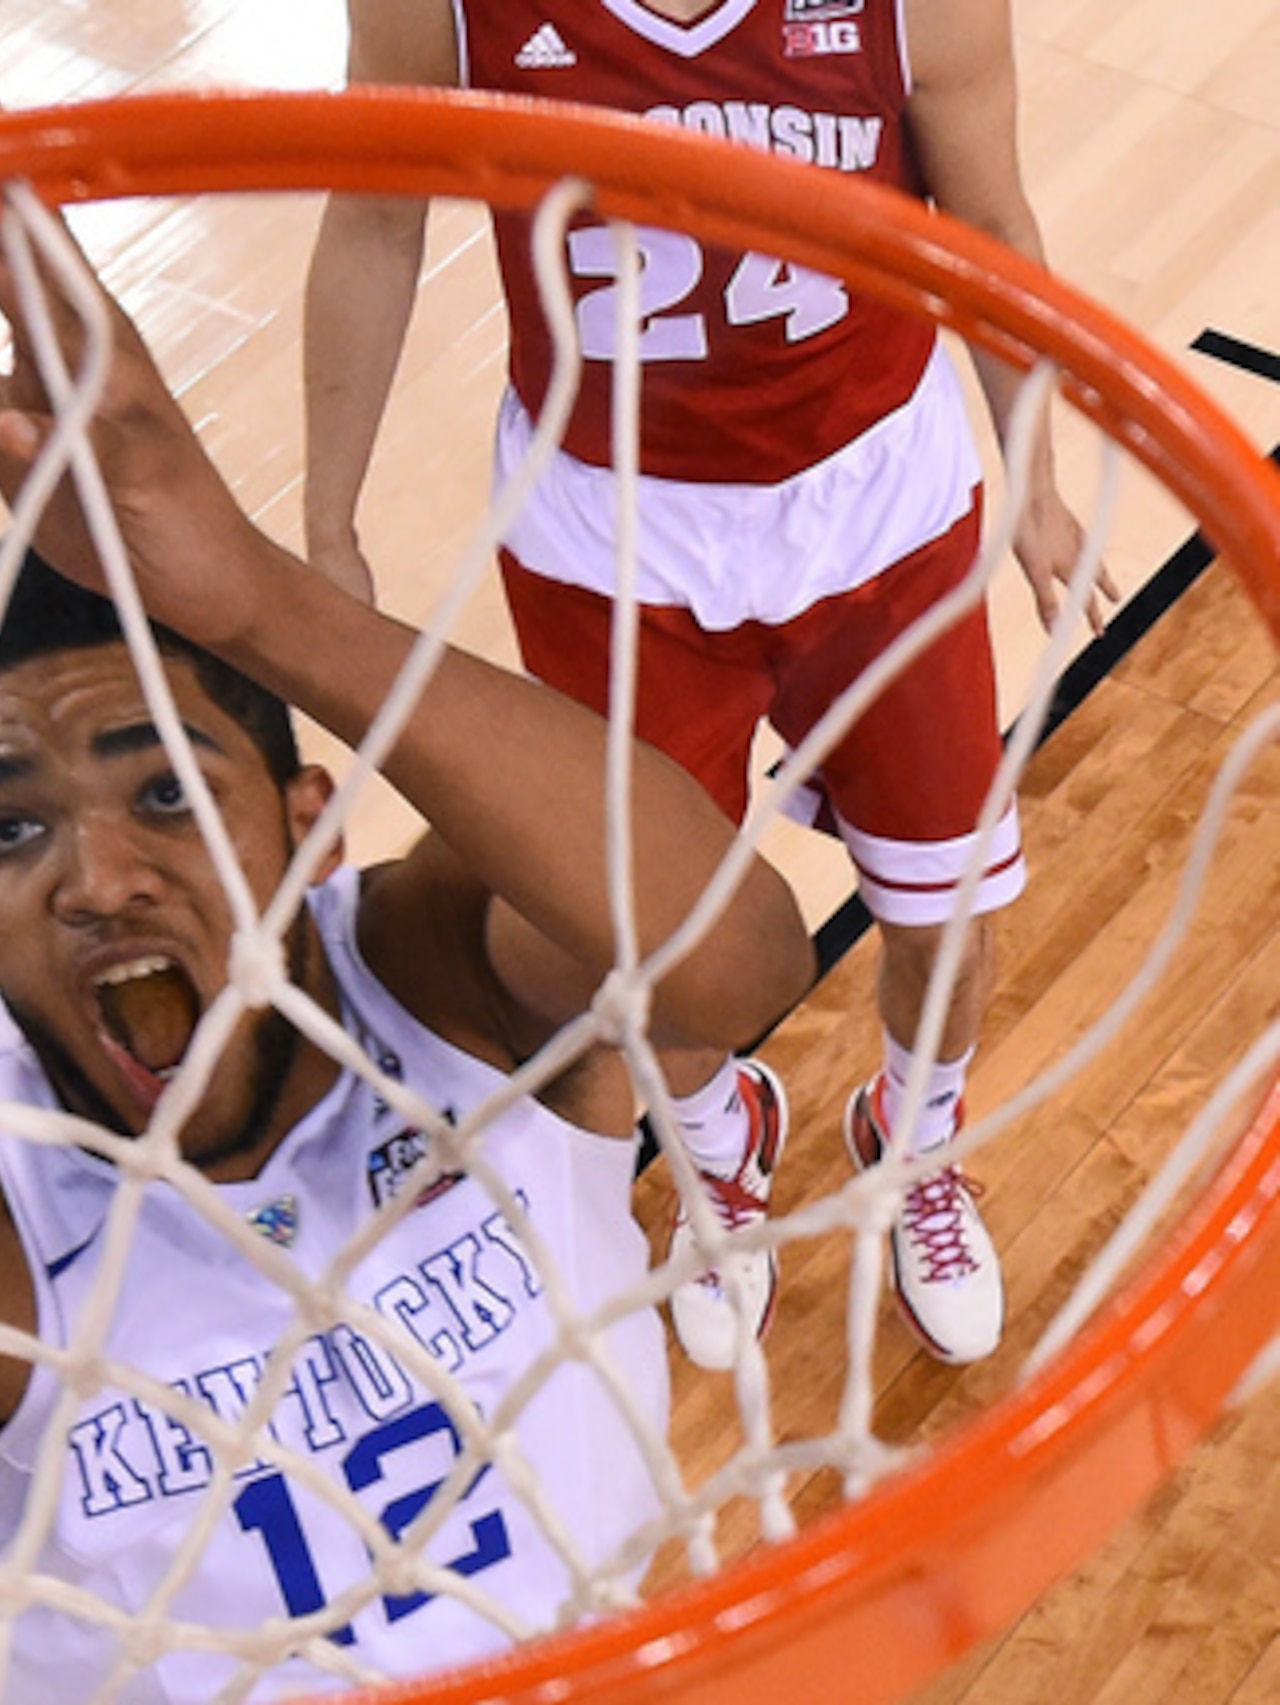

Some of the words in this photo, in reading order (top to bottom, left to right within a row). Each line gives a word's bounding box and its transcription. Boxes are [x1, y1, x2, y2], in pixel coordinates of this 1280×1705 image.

[643, 99, 883, 172] ONSIN
[567, 224, 849, 361] 24
[67, 1187, 544, 1518] KENTUCKY
[232, 1400, 512, 1648] 12
